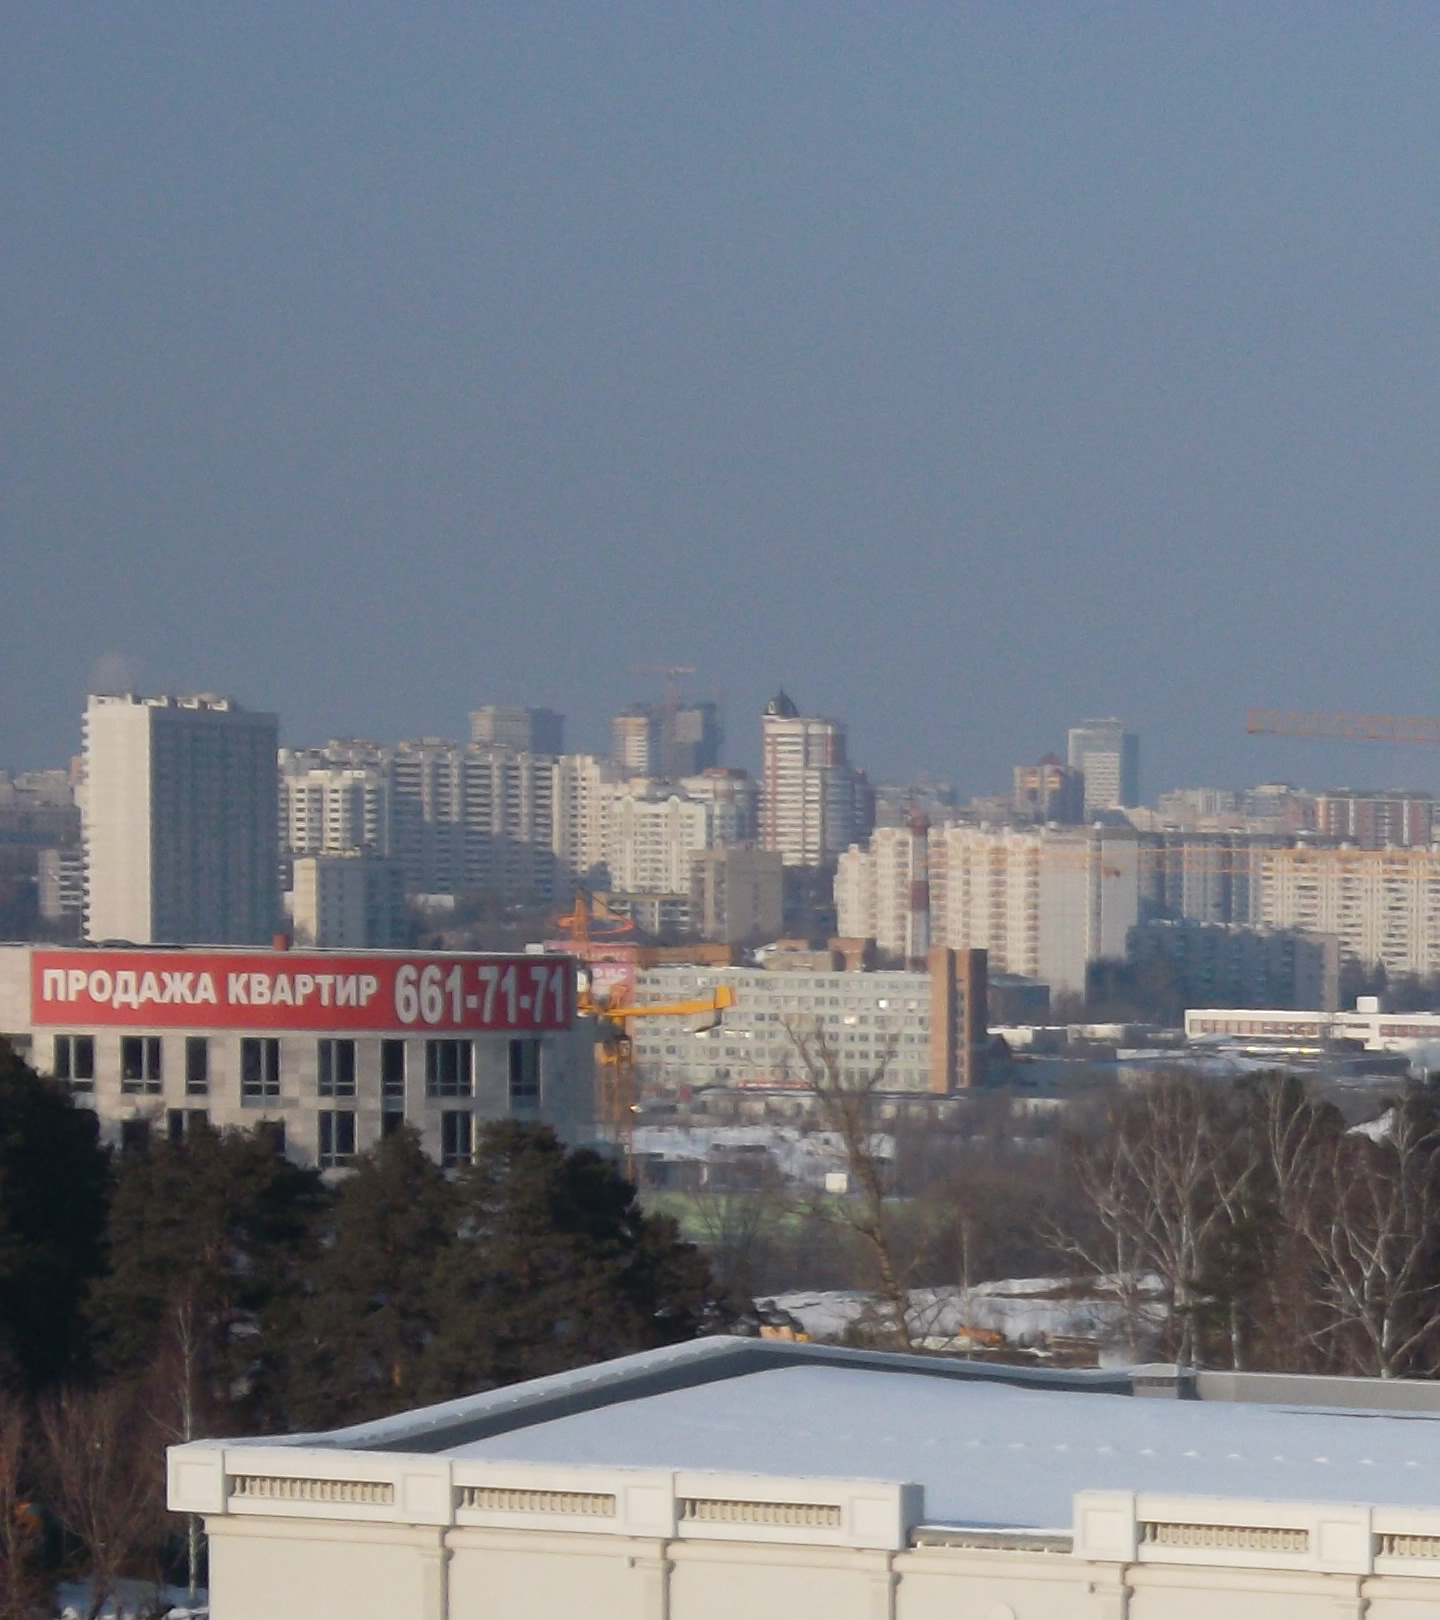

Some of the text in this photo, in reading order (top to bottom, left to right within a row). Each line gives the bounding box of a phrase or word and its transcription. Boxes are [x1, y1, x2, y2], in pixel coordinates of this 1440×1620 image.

[42, 963, 566, 1025] ПРОДАЖА КВАРТИР 661-71-71
